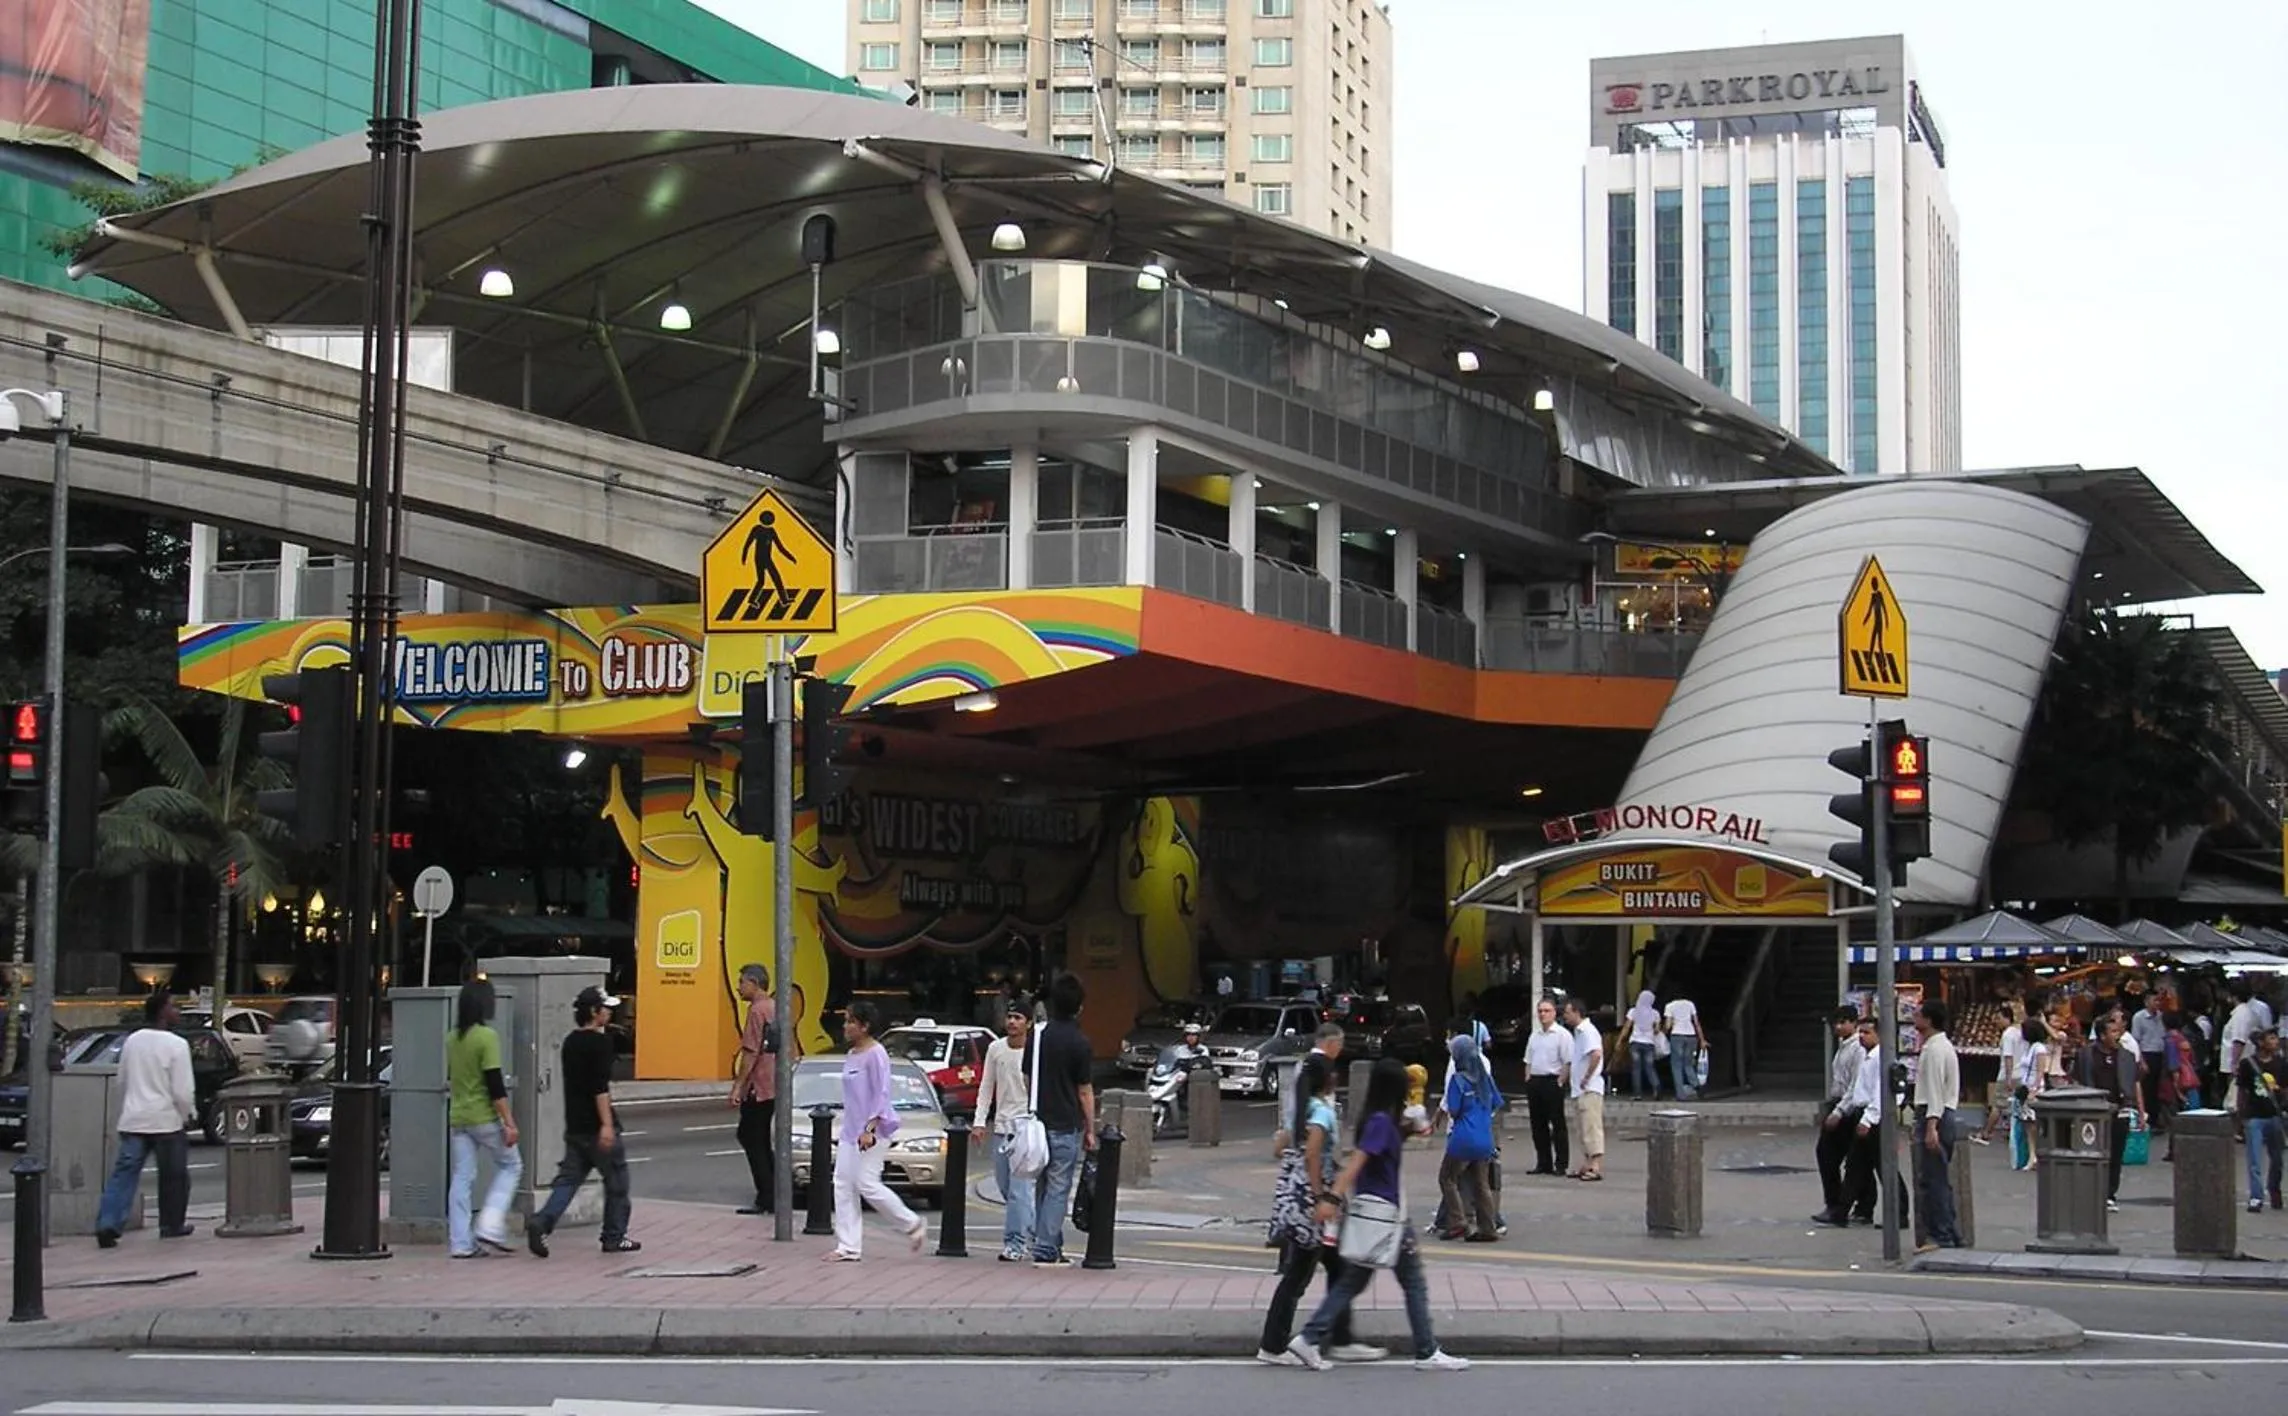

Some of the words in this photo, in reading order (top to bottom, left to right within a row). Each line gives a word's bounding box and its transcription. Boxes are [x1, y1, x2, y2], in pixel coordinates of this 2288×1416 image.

[1650, 67, 1890, 111] PARKROYAL
[602, 638, 690, 691] CLUB
[870, 796, 982, 855] WIDEST
[986, 804, 1078, 844] COVERAGE
[1595, 804, 1770, 845] MONORAIL
[902, 873, 956, 907] Always
[961, 877, 994, 905] with
[1600, 863, 1655, 882] BUKIT
[1623, 891, 1702, 908] BINTANG
[663, 942, 694, 956] DiGi
